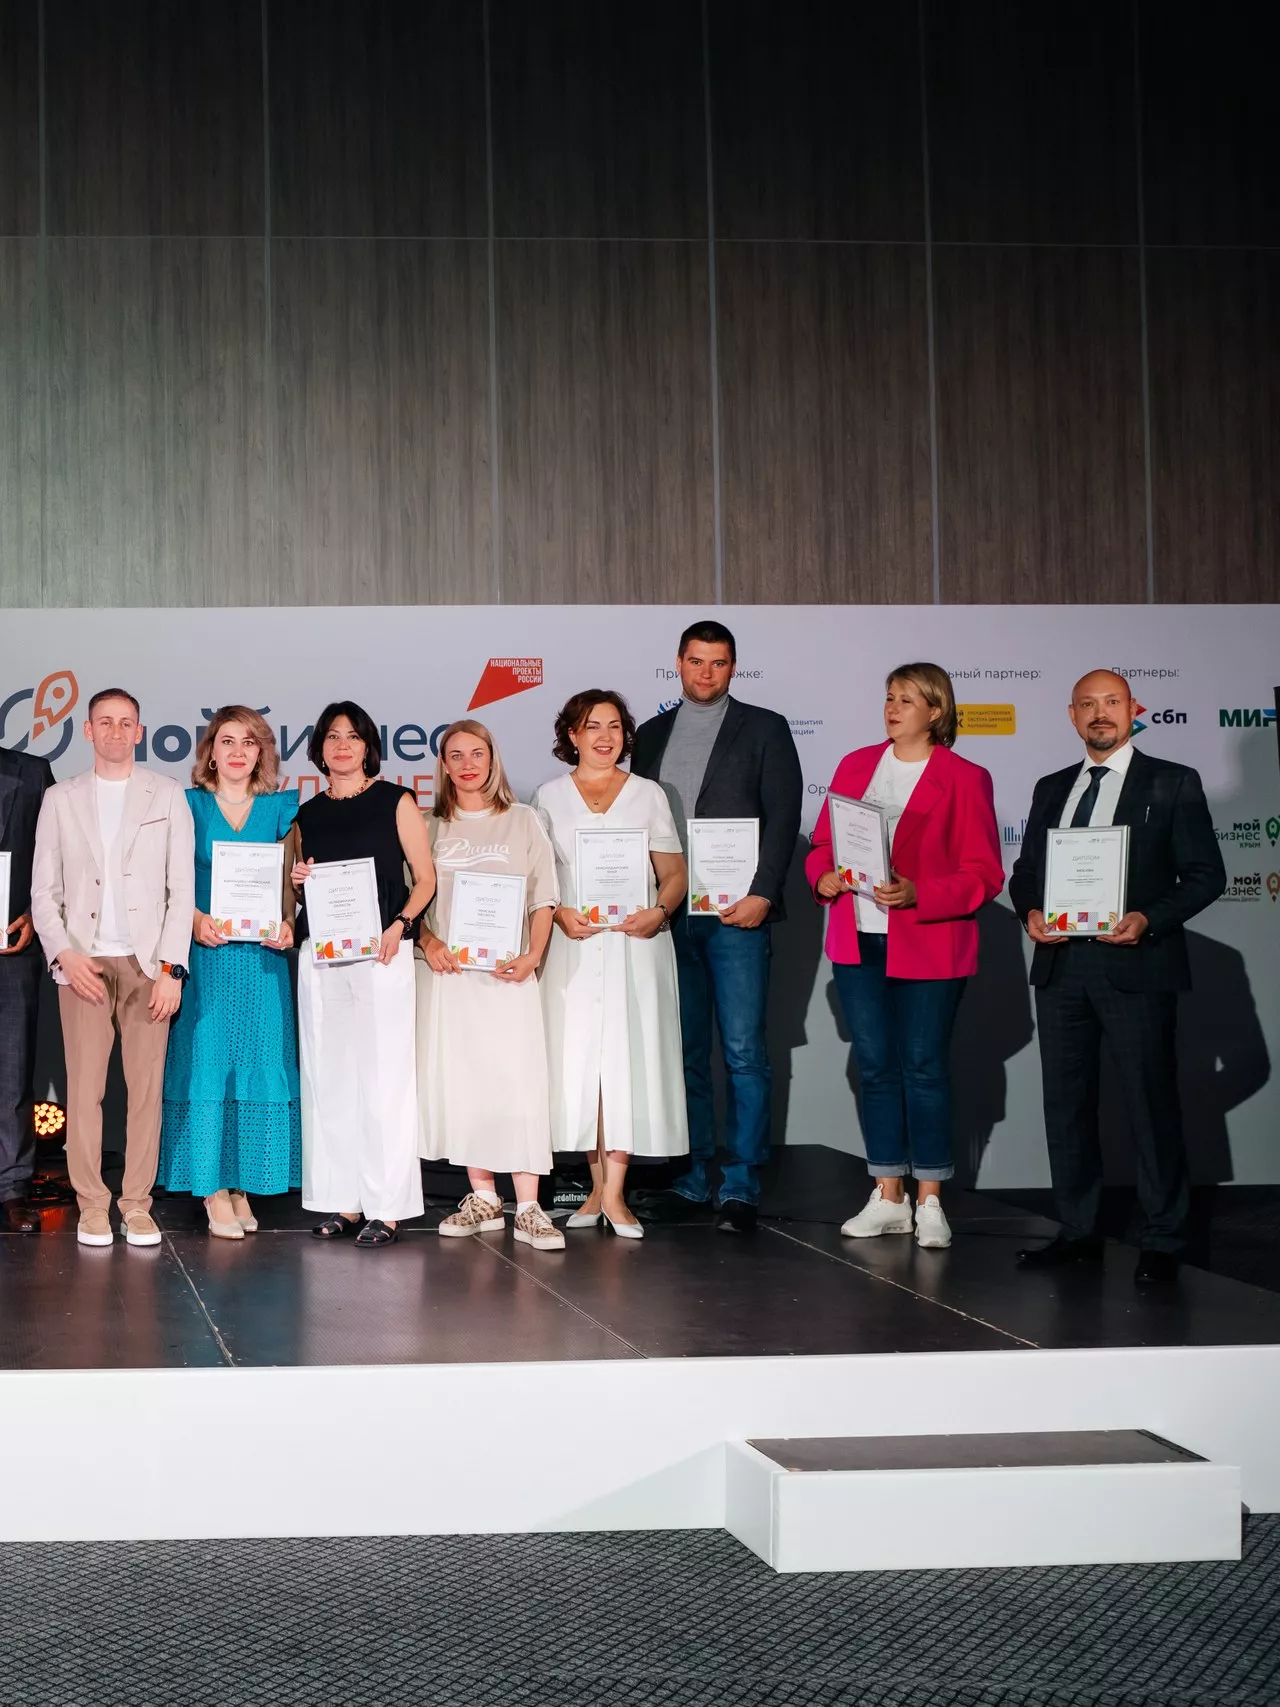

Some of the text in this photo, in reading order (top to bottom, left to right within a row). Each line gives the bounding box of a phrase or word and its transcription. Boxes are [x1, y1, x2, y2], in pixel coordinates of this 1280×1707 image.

[490, 659, 541, 667] НАЦИОНАЛЬНЫЕ
[512, 667, 542, 675] ПРОЕКТЫ
[984, 669, 1042, 680] партнер:
[1111, 667, 1180, 679] Партнеры:
[517, 675, 542, 683] РОССИИ
[1151, 709, 1187, 724] сбп
[1222, 887, 1261, 896] изнес
